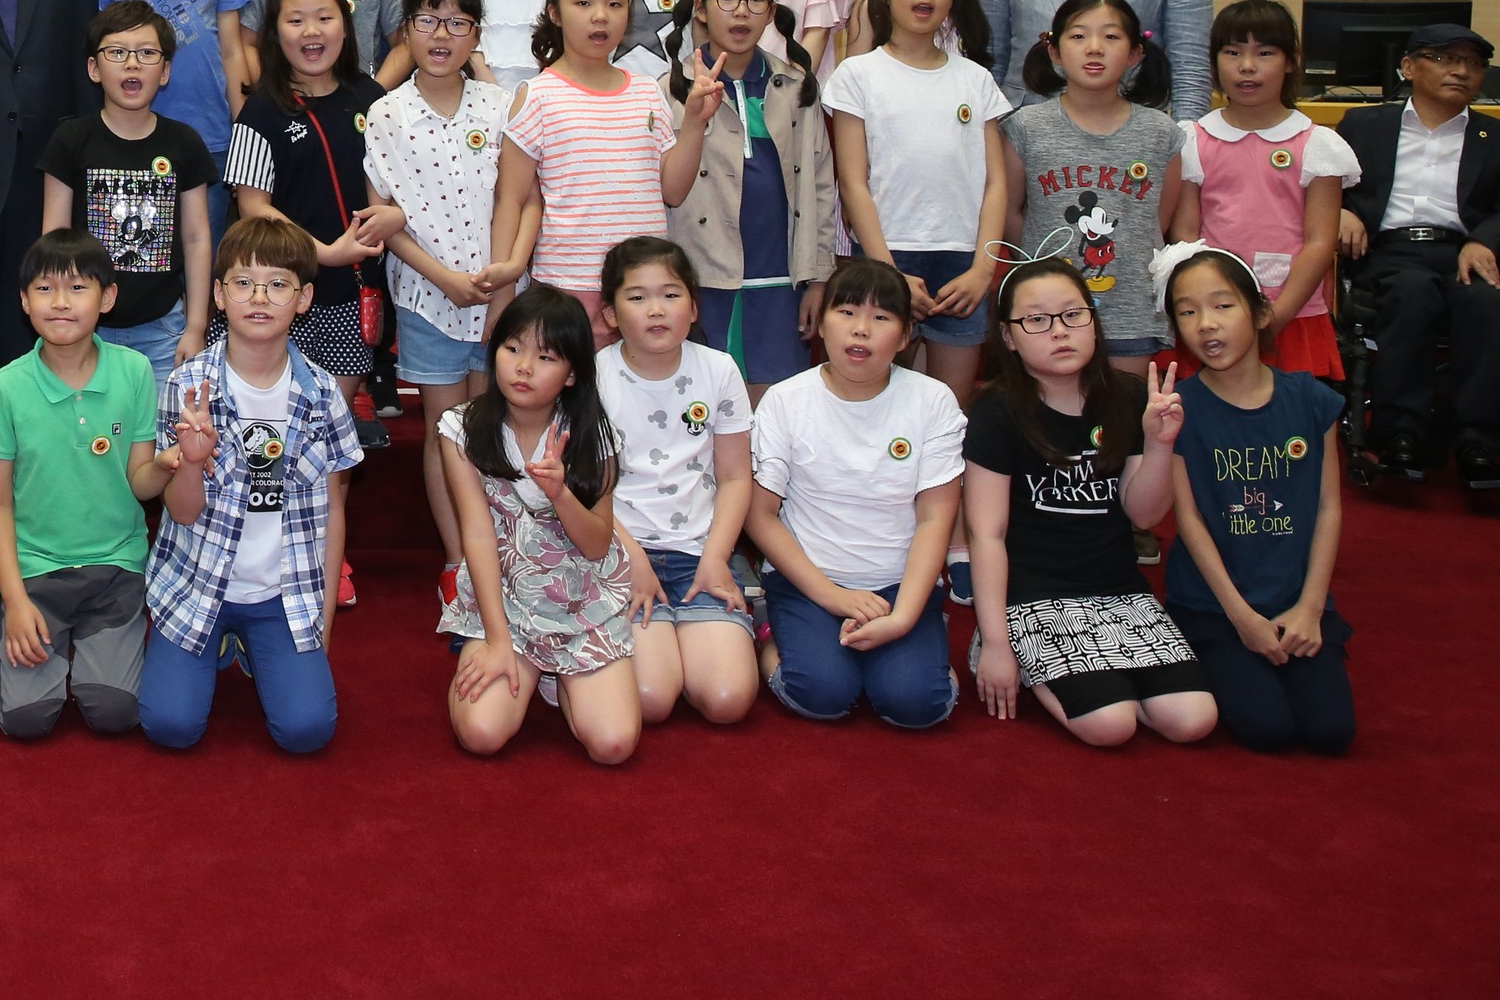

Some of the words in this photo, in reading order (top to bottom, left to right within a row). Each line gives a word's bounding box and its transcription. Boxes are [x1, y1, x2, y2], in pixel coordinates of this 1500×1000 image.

[1037, 165, 1153, 200] MICKEY
[1214, 445, 1290, 481] DREAM
[1244, 486, 1266, 515] big
